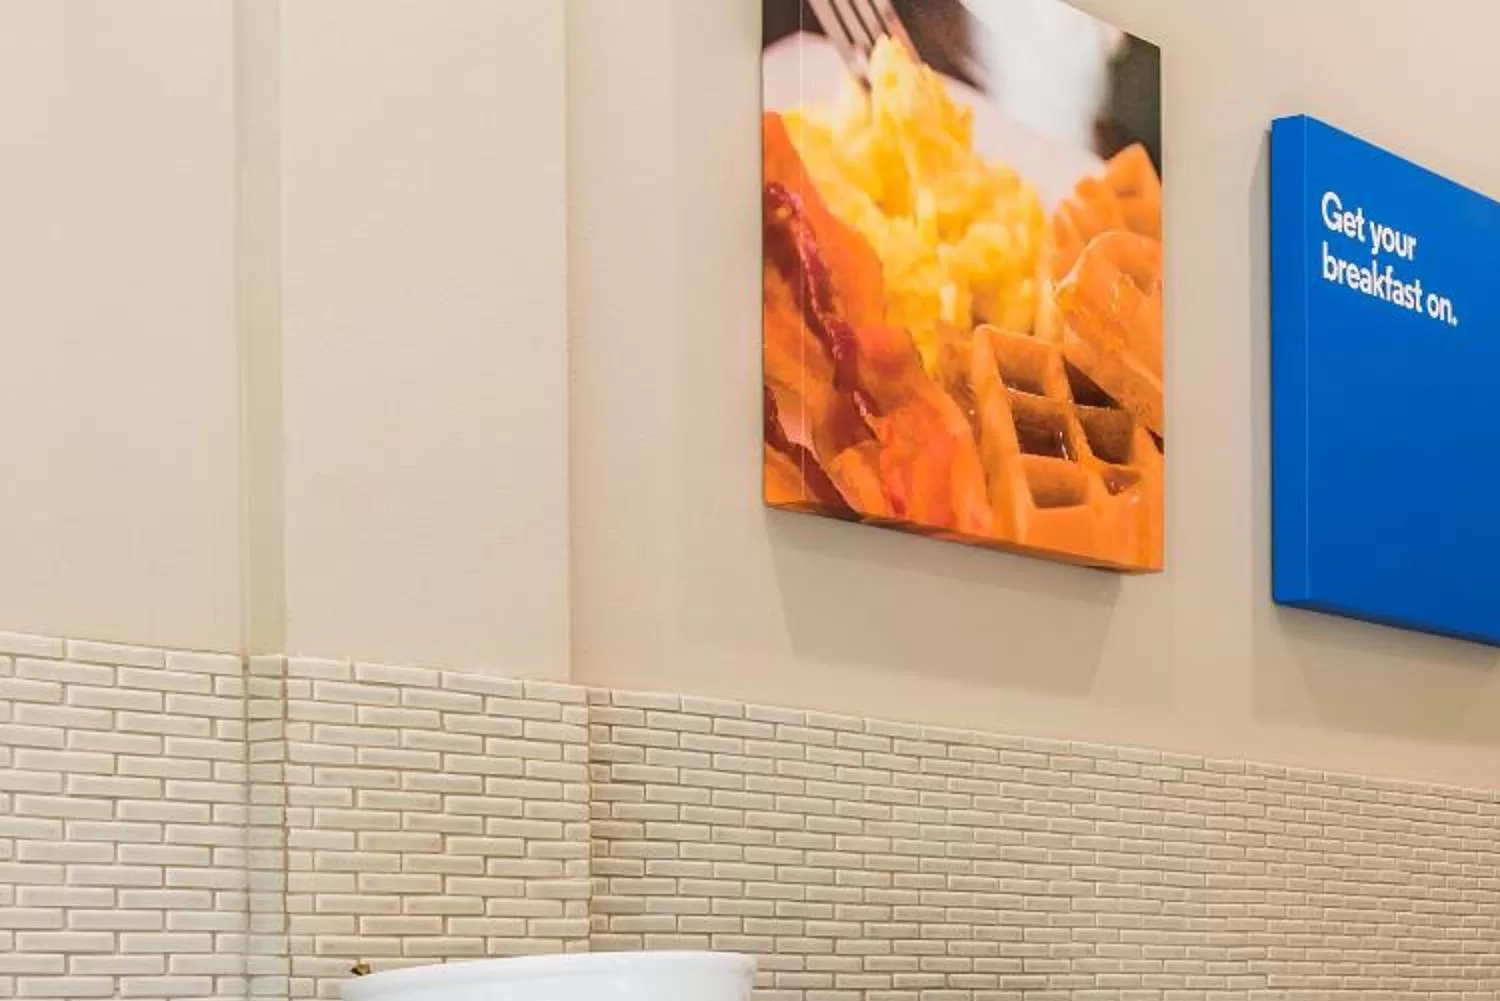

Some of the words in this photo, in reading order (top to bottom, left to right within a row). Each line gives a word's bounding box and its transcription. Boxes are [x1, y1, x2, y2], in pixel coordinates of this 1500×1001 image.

[1321, 191, 1365, 242] Get
[1369, 221, 1417, 261] your
[1321, 240, 1423, 313] breakfast
[1427, 292, 1458, 327] on.
